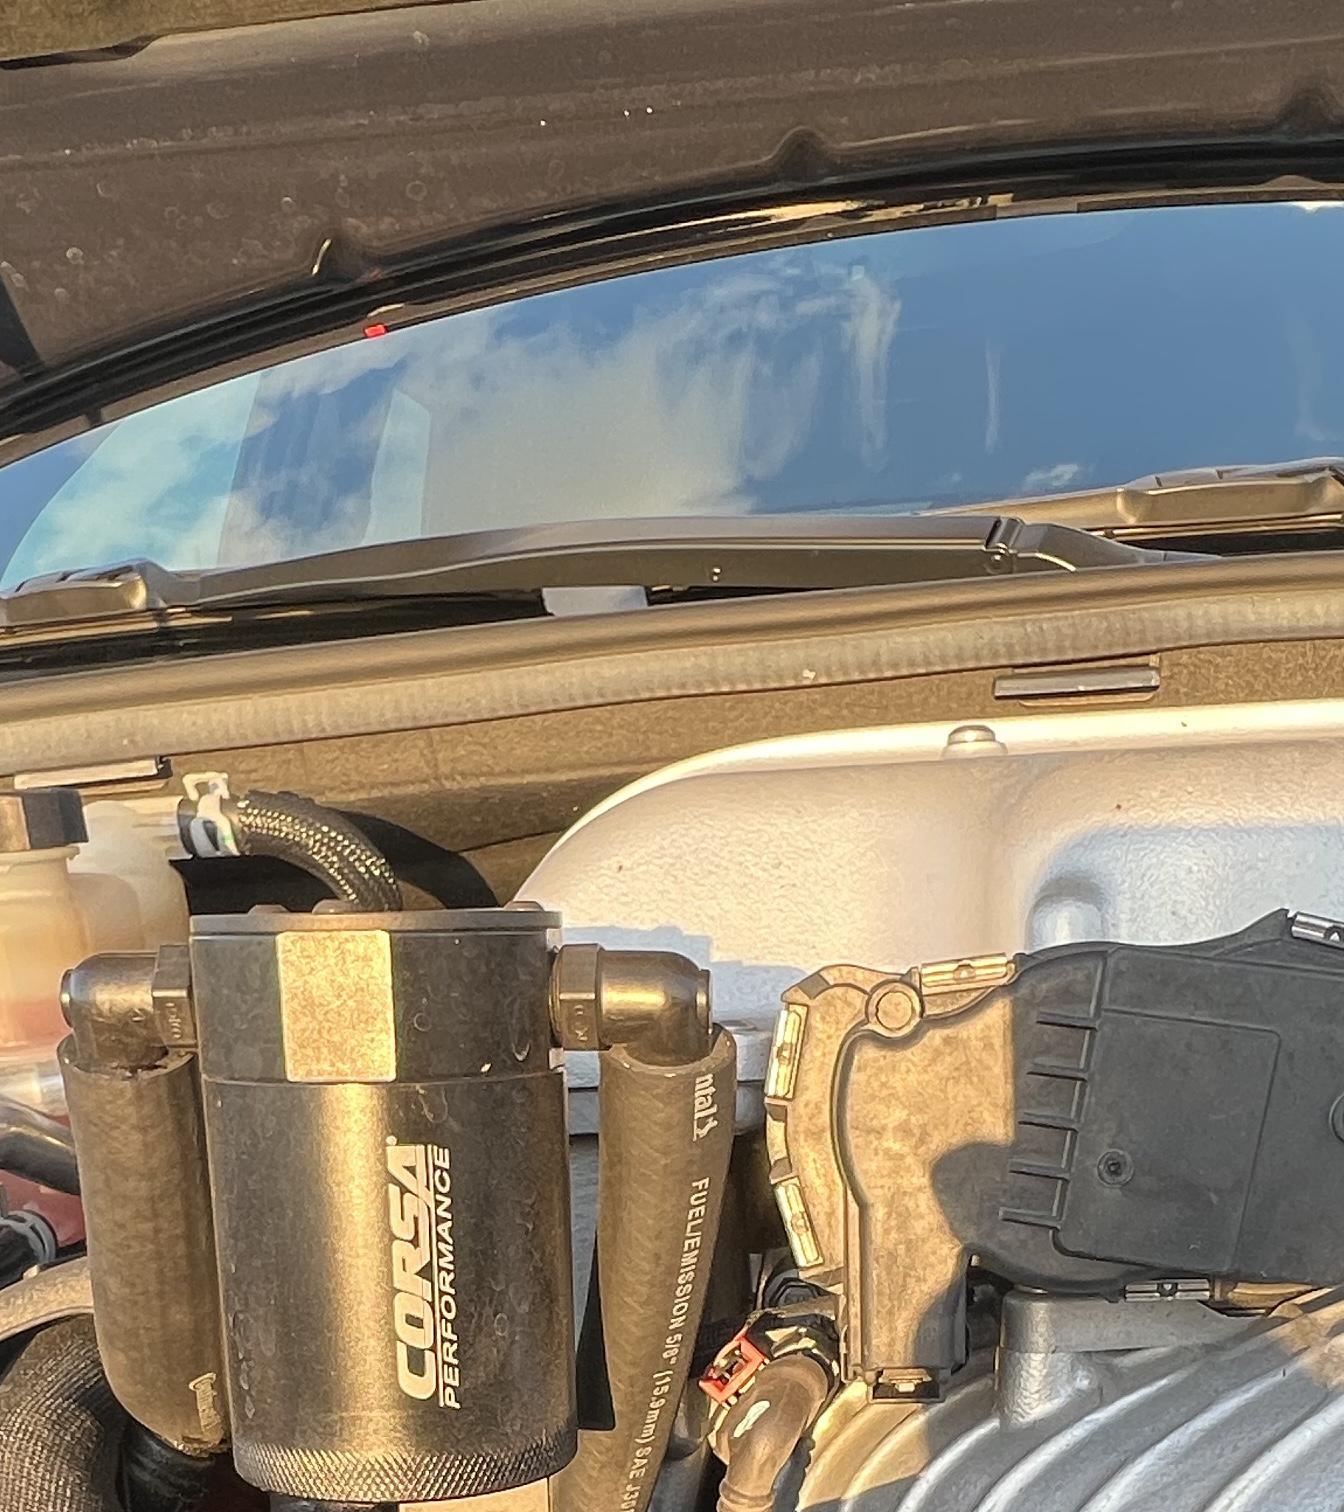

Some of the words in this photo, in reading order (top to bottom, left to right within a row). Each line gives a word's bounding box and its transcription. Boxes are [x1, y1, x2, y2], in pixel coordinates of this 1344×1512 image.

[386, 1143, 437, 1400] CORSA
[433, 1145, 461, 1410] PERFORMANCE
[668, 1177, 710, 1330] FUEL/EMISSION
[629, 1446, 653, 1480] SAE
